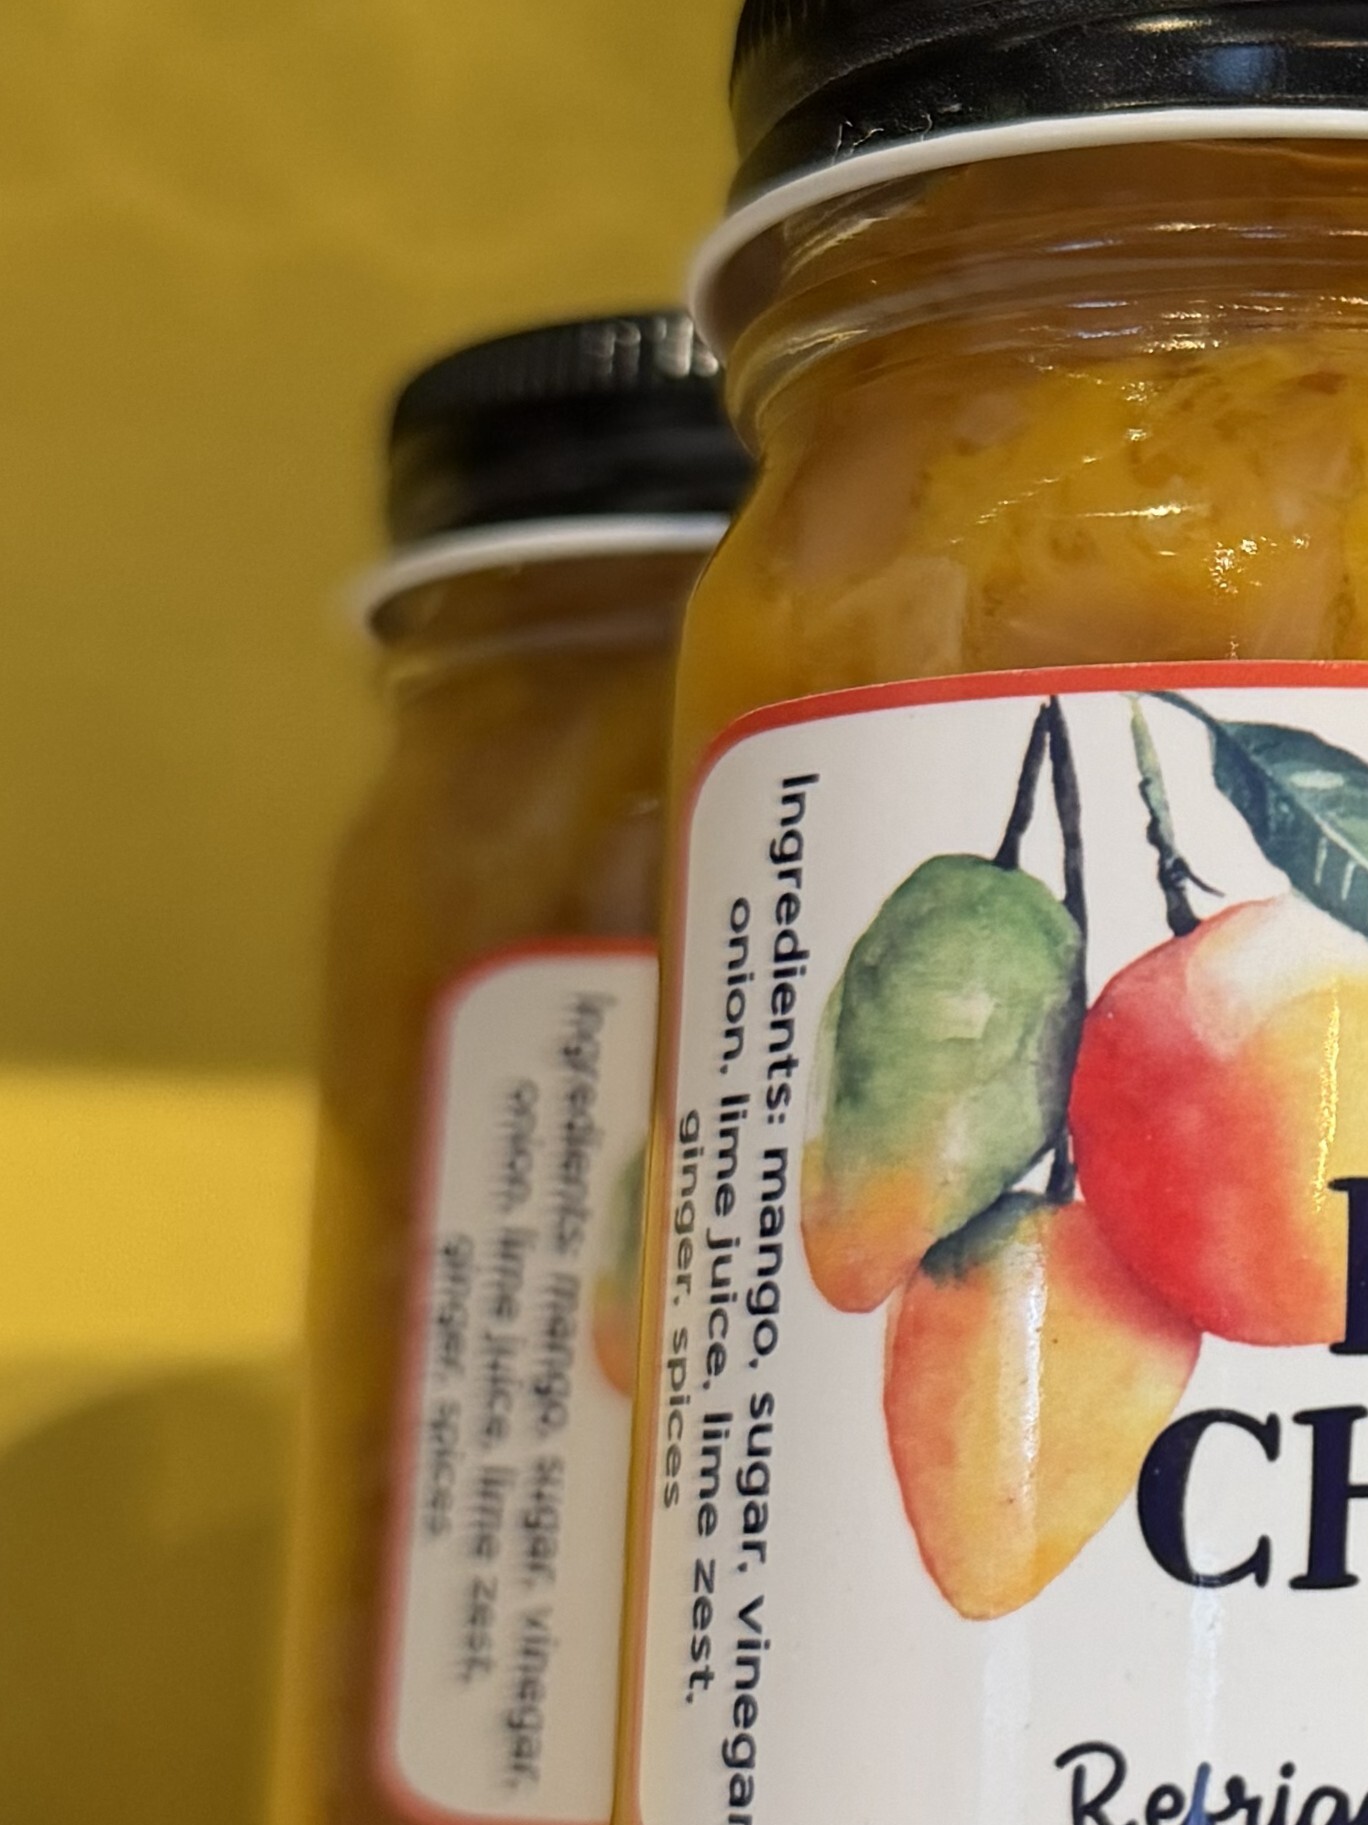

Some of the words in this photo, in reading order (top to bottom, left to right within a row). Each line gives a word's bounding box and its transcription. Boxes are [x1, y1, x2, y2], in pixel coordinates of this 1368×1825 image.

[766, 773, 821, 1125] Ingredients:
[713, 1093, 751, 1217] lime
[661, 1325, 692, 1509] spices
[696, 1413, 733, 1538] lime
